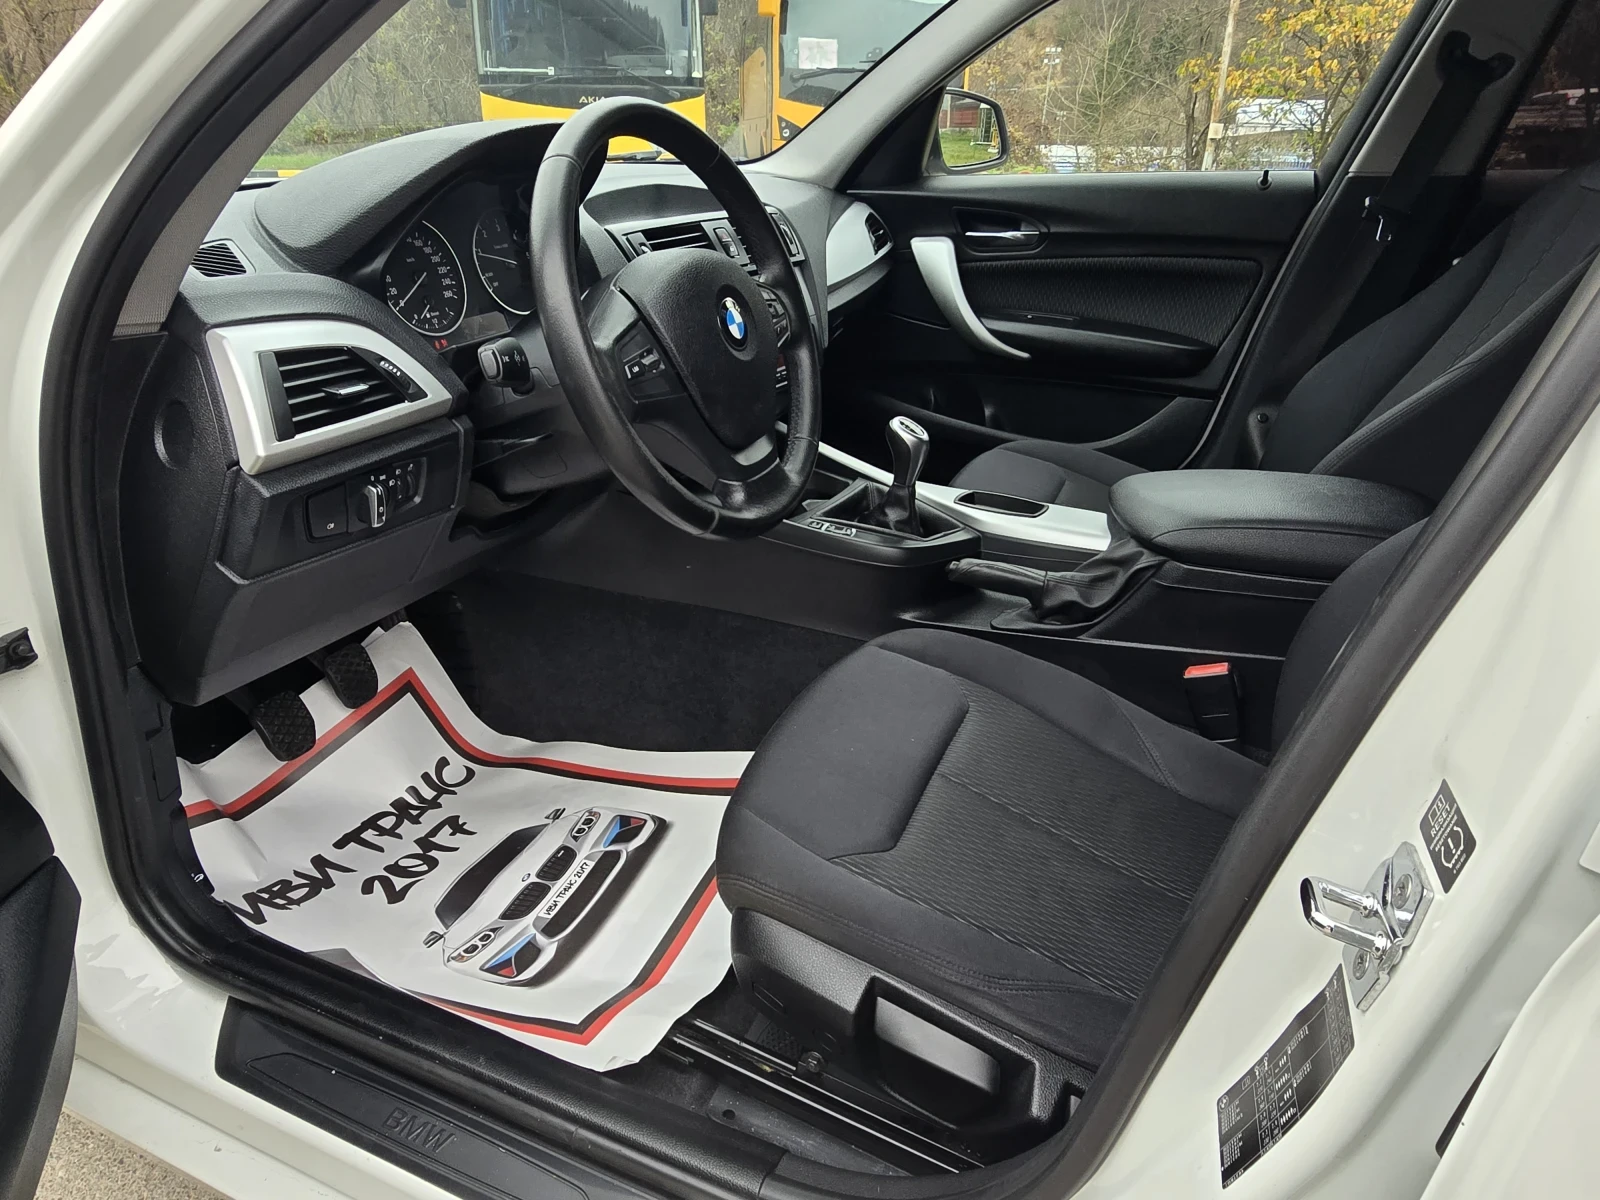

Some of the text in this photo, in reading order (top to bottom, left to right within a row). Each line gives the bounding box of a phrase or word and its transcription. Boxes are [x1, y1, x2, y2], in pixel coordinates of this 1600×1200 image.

[437, 266, 447, 274] 220
[441, 278, 452, 286] 240
[442, 290, 453, 298] 260
[1430, 802, 1450, 837] RESET
[361, 815, 477, 905] 2017
[382, 1107, 456, 1153] BMW
